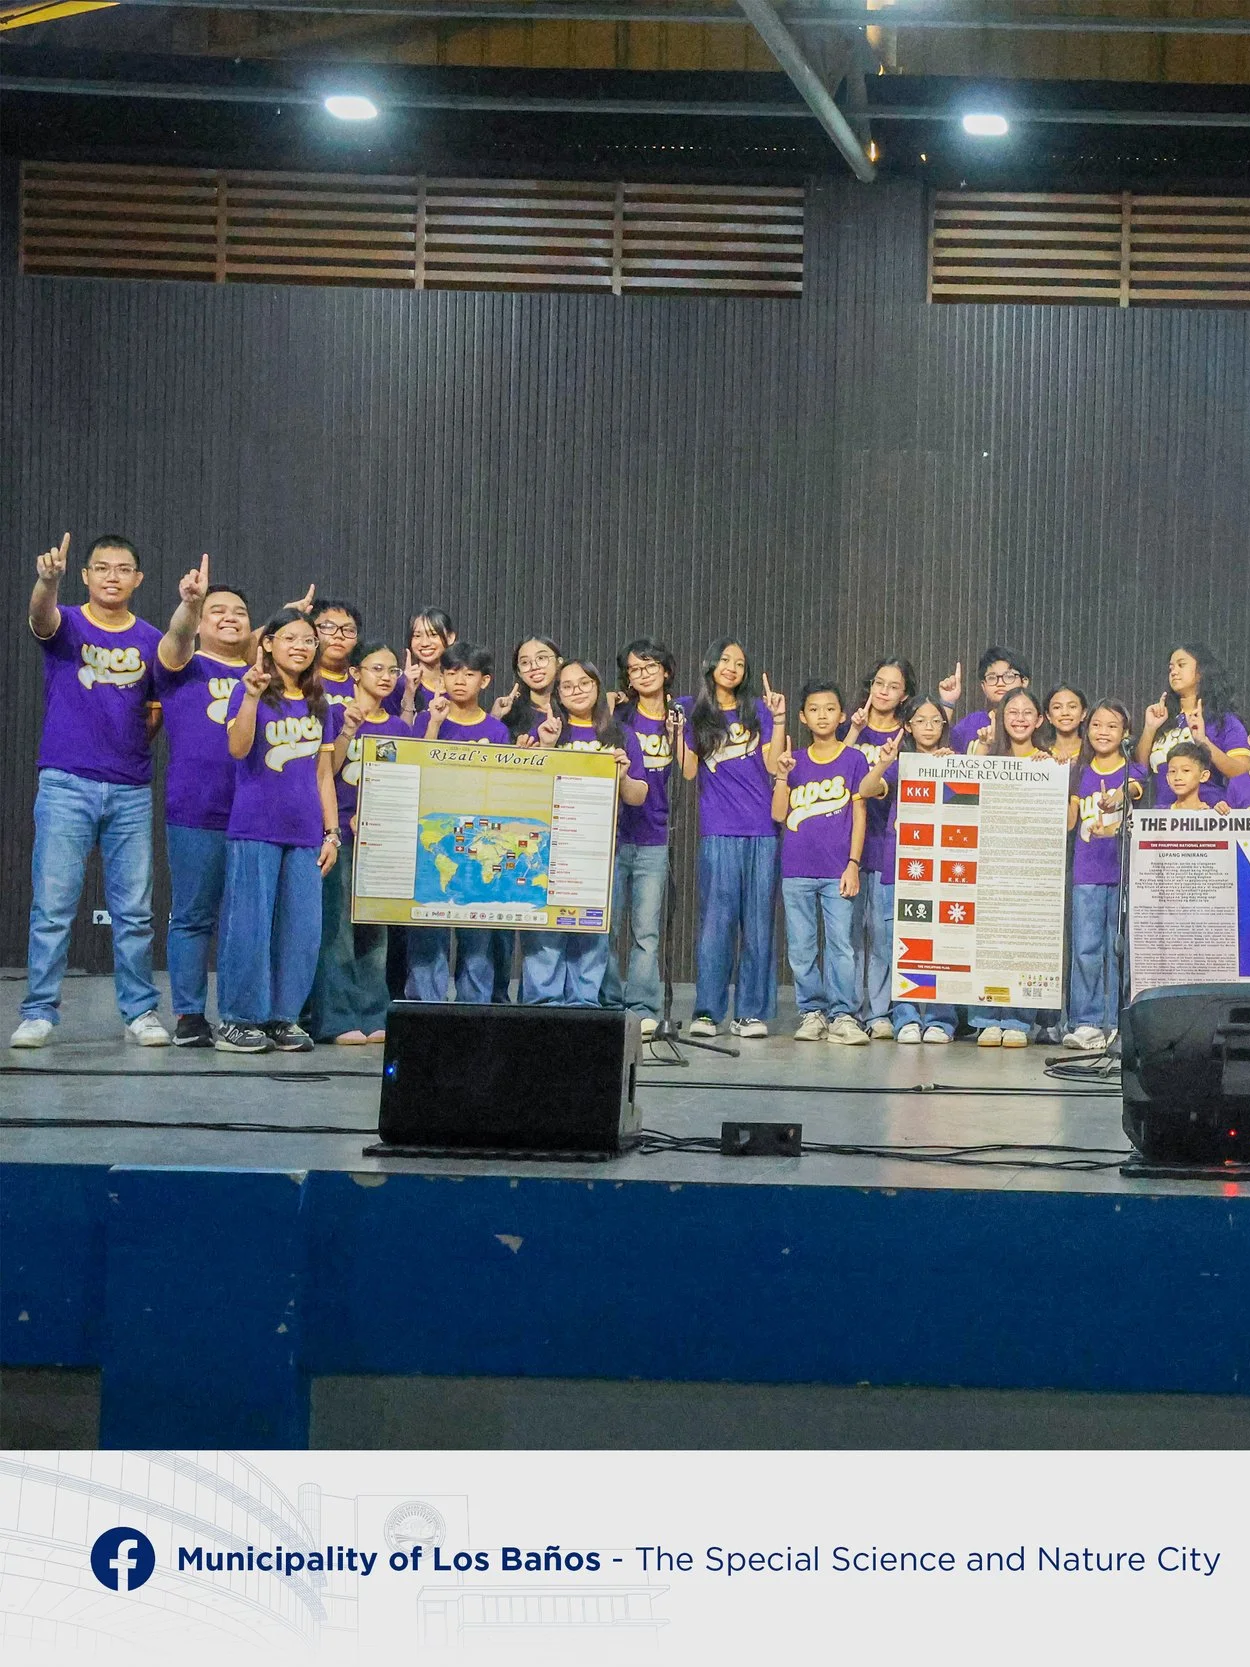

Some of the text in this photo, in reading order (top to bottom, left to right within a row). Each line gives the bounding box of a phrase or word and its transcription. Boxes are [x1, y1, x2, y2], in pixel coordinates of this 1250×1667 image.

[429, 748, 488, 763] Rizal's
[494, 752, 548, 766] World
[946, 758, 1023, 771] FLAGS OF THE
[918, 767, 1050, 782] PHILIPPINE REVOLUTION
[1140, 817, 1167, 832] THE
[913, 829, 920, 840] K
[904, 903, 913, 917] K
